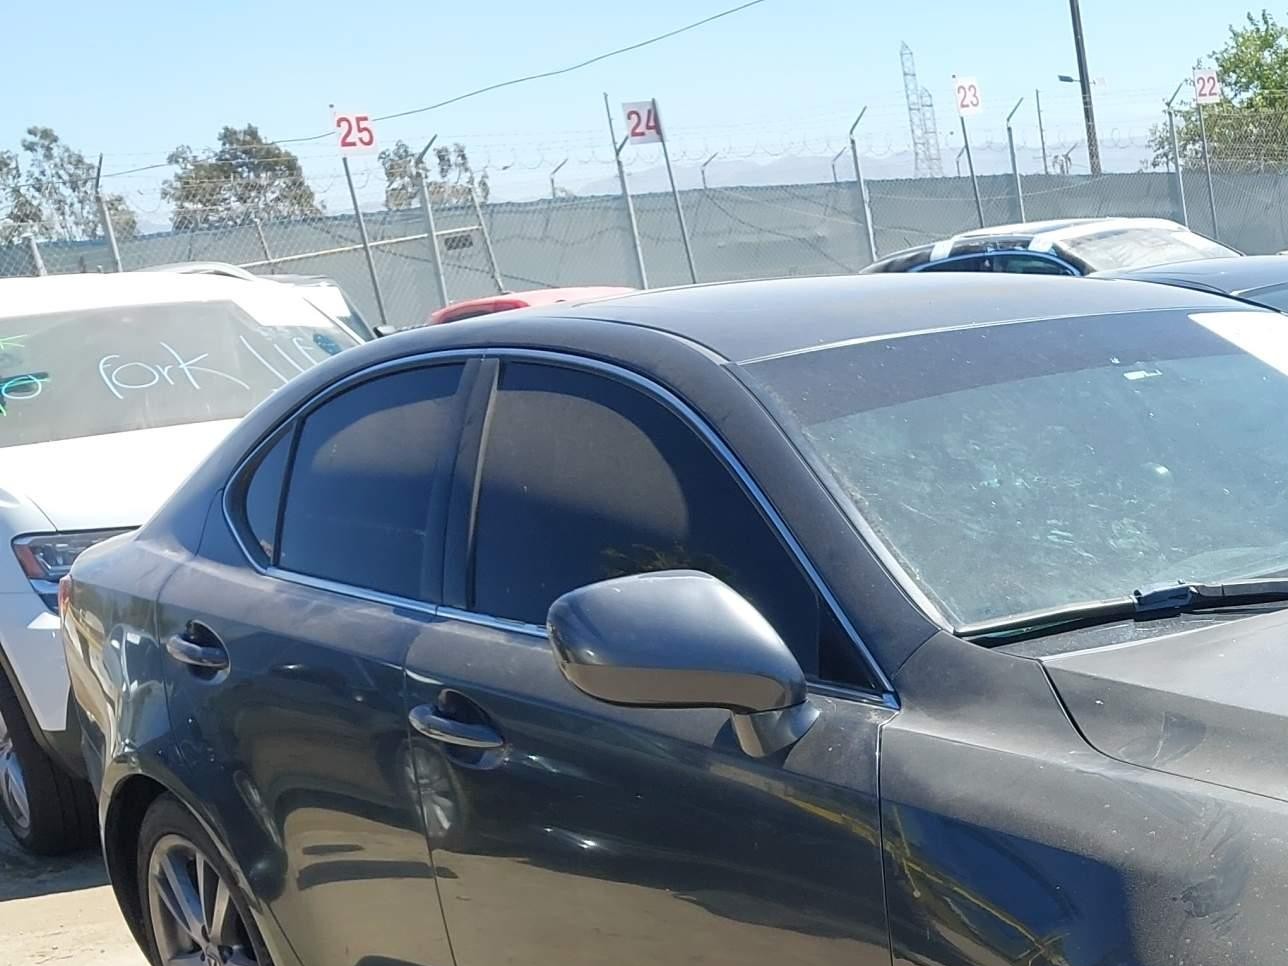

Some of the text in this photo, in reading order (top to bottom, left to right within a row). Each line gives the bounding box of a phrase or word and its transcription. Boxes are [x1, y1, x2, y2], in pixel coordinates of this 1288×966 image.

[957, 84, 980, 107] 23
[1197, 76, 1217, 96] 22
[336, 116, 374, 147] 25
[627, 109, 662, 137] 24
